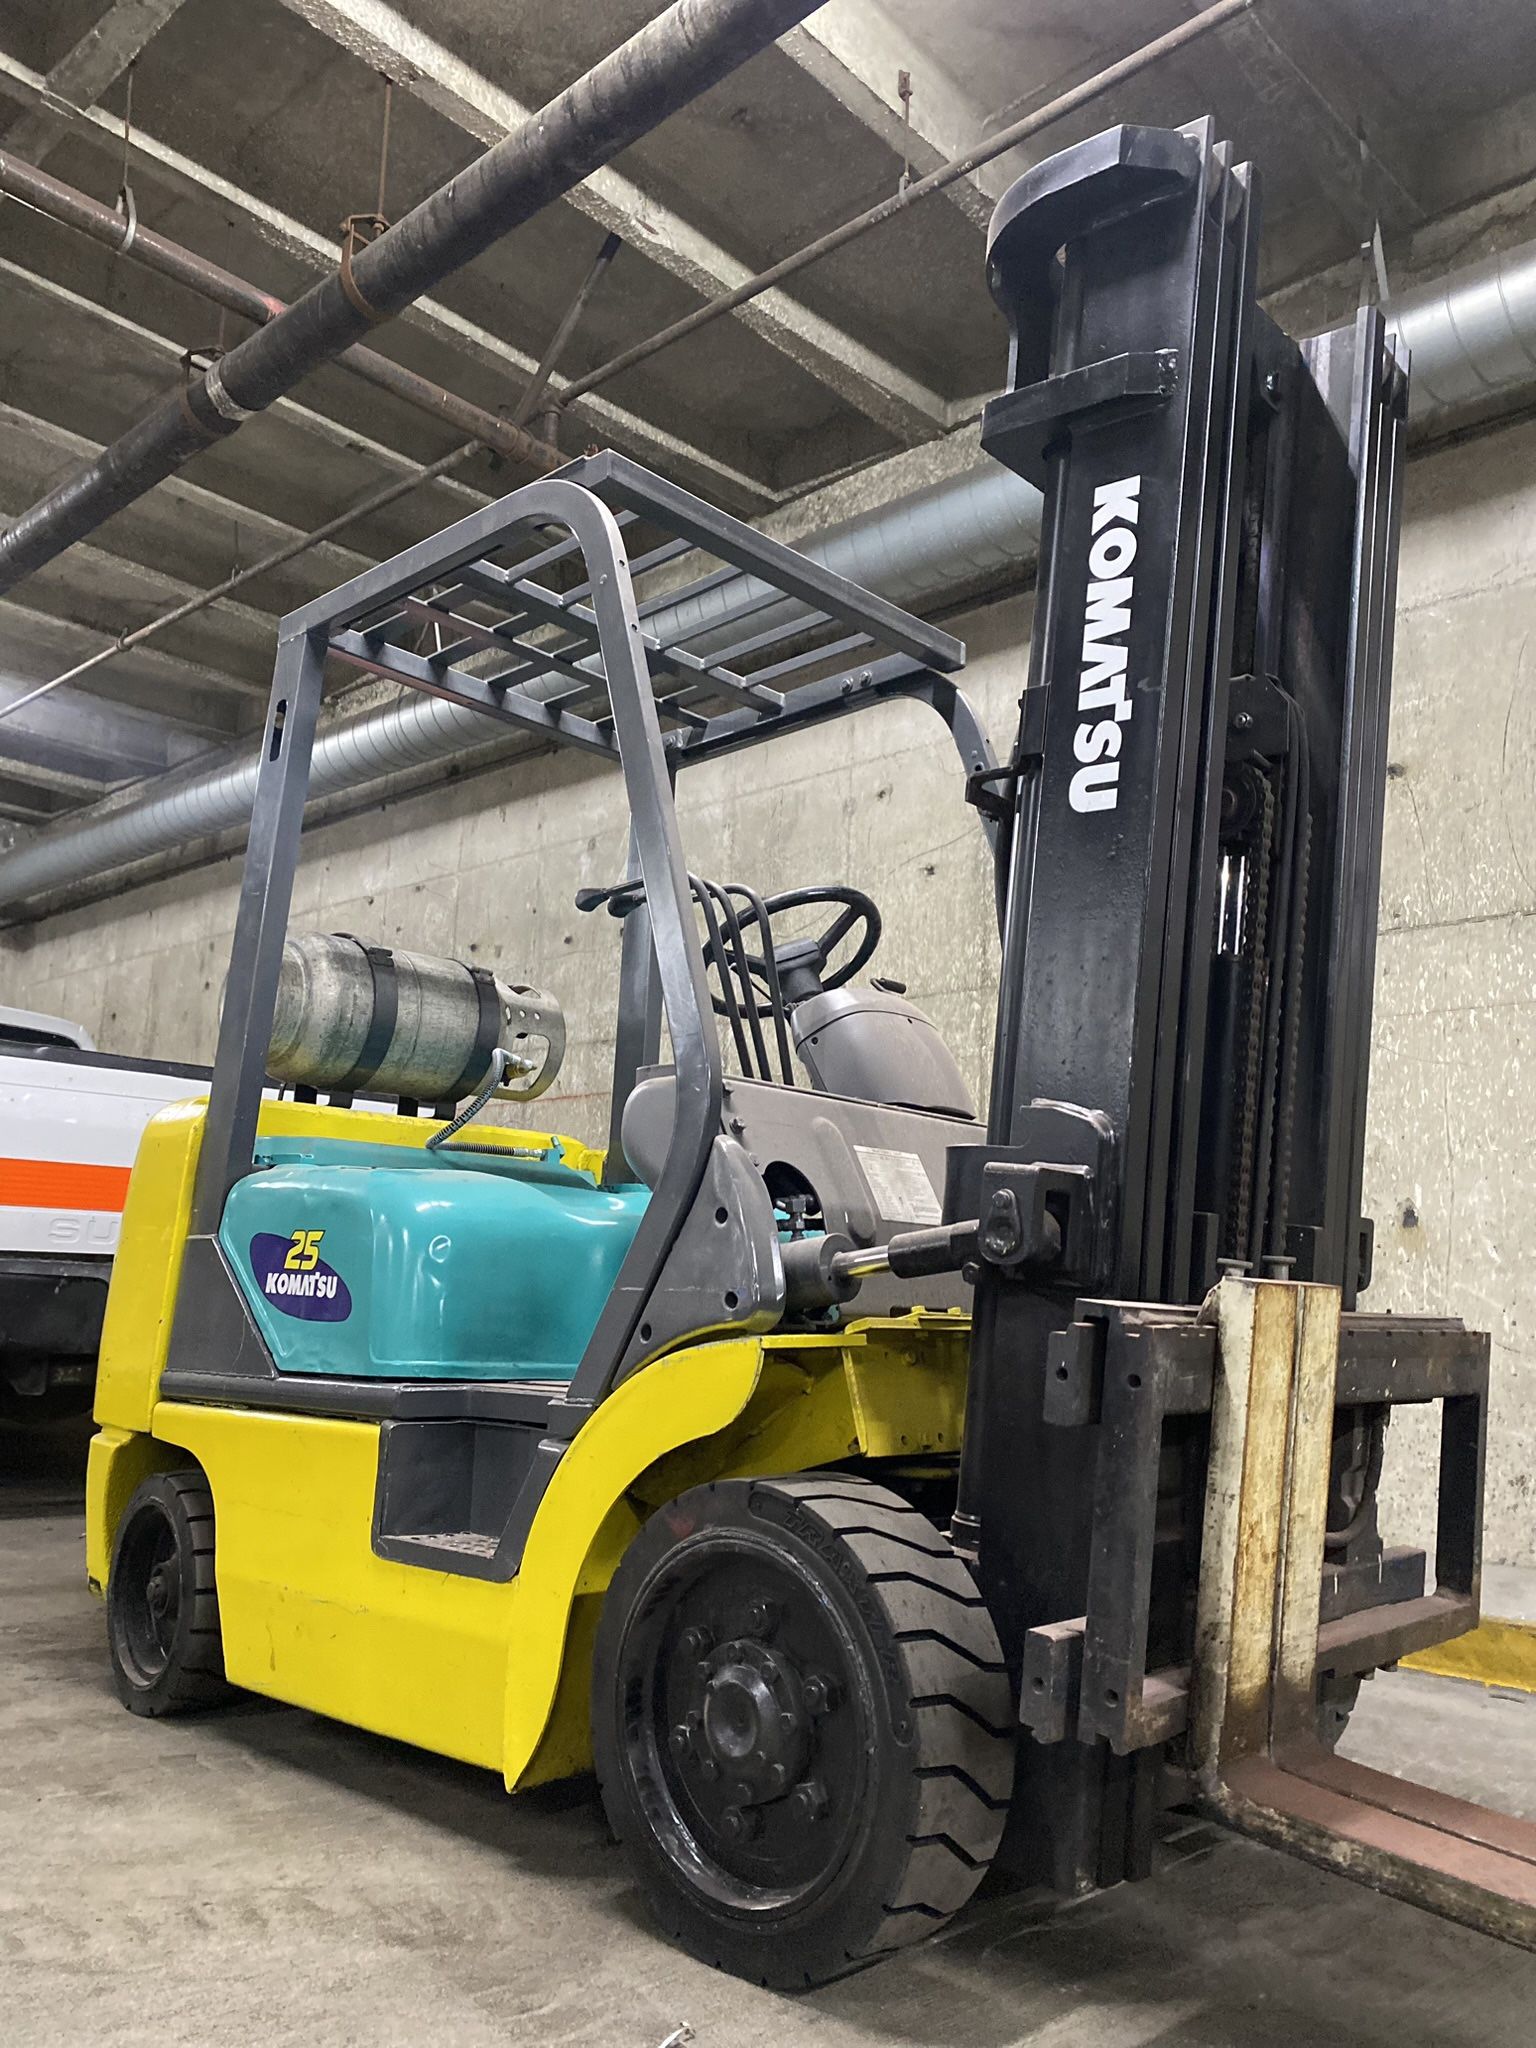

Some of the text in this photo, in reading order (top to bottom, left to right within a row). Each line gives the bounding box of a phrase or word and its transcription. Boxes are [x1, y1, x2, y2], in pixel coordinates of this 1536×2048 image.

[1069, 475, 1141, 813] KOMATSU
[284, 1230, 326, 1270] 25
[265, 1271, 338, 1299] KOMATSU
